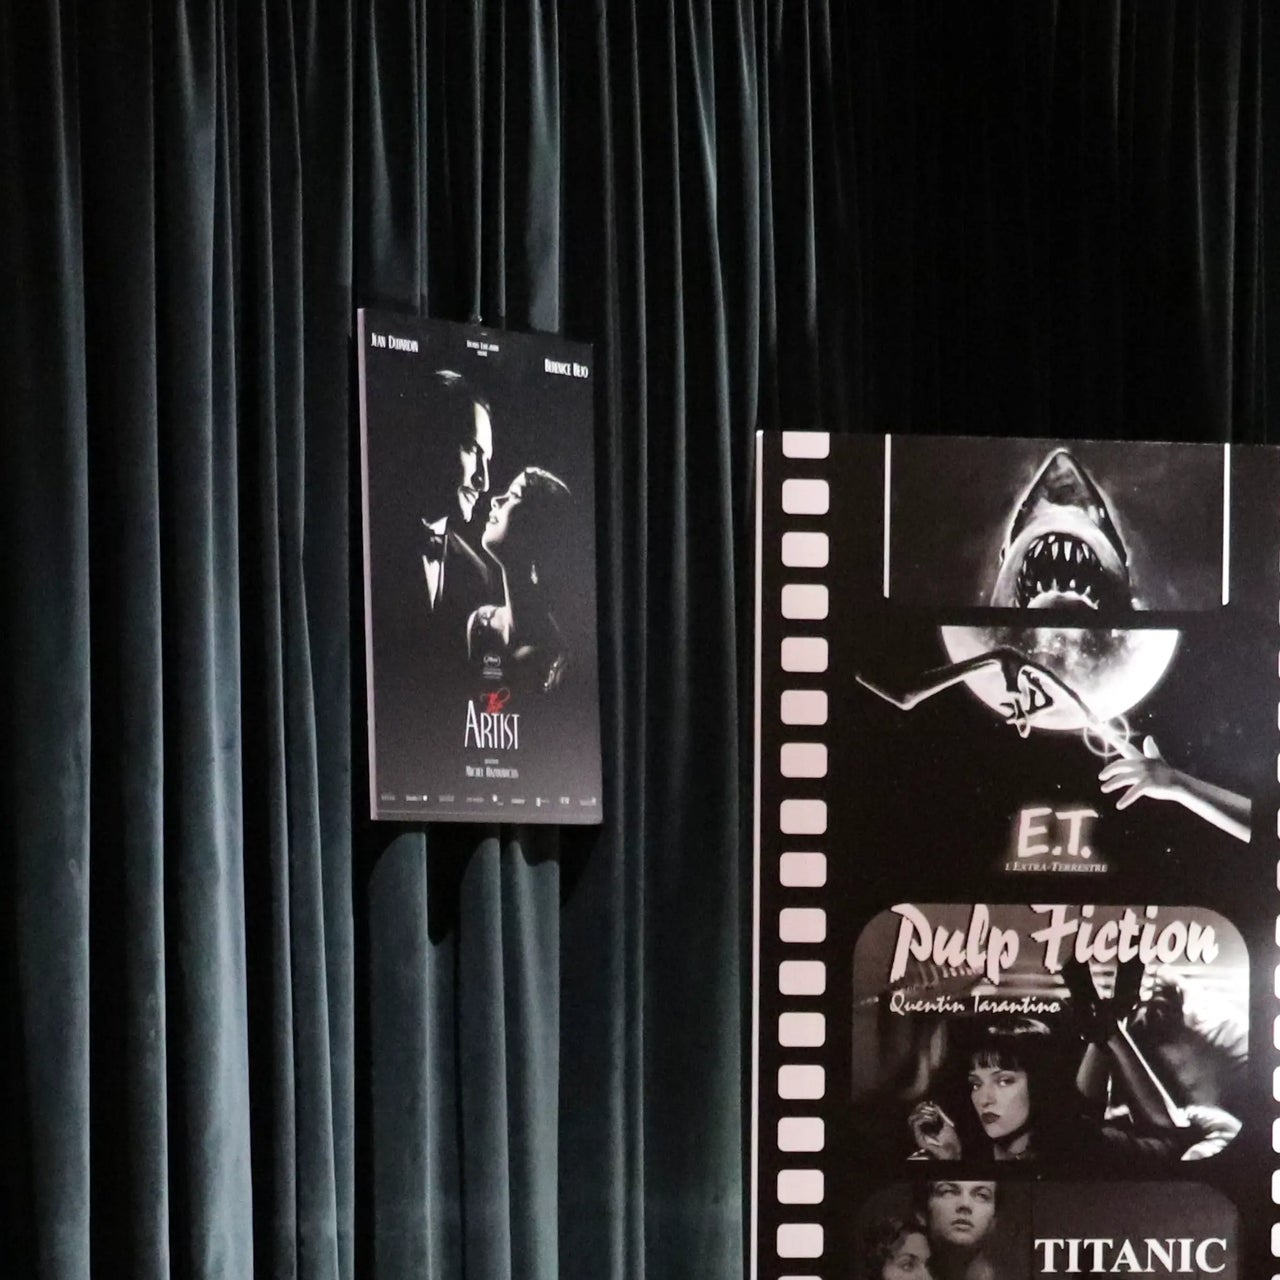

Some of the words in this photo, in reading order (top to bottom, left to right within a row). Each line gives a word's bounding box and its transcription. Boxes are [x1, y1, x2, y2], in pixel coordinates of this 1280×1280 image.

[464, 699, 520, 750] ARTIST
[1018, 807, 1099, 859] E.T.
[889, 903, 1020, 985] Pulp
[1031, 904, 1219, 974] Fiction
[889, 988, 965, 1016] Quentin
[970, 993, 1061, 1014] Tarantino
[1034, 1238, 1227, 1274] TITANIC
